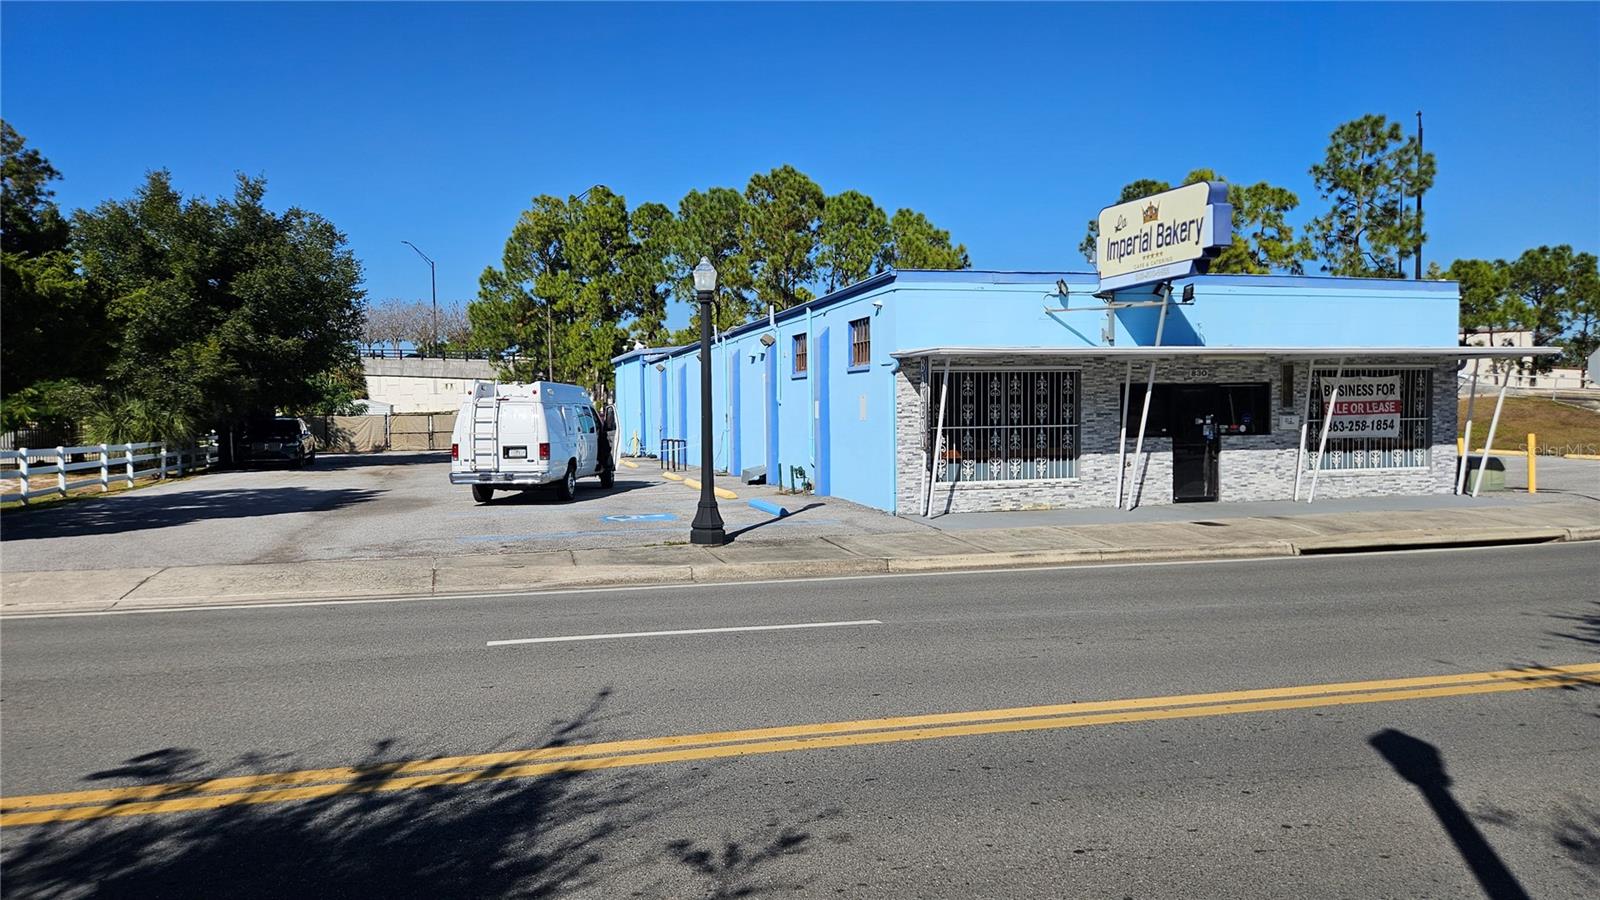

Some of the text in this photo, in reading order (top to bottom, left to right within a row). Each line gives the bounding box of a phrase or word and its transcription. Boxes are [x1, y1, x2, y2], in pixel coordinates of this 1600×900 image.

[1106, 217, 1204, 263] Imperial Bakery
[1376, 383, 1396, 396] FOR
[1350, 402, 1364, 414] OR
[1366, 401, 1396, 413] LEASE
